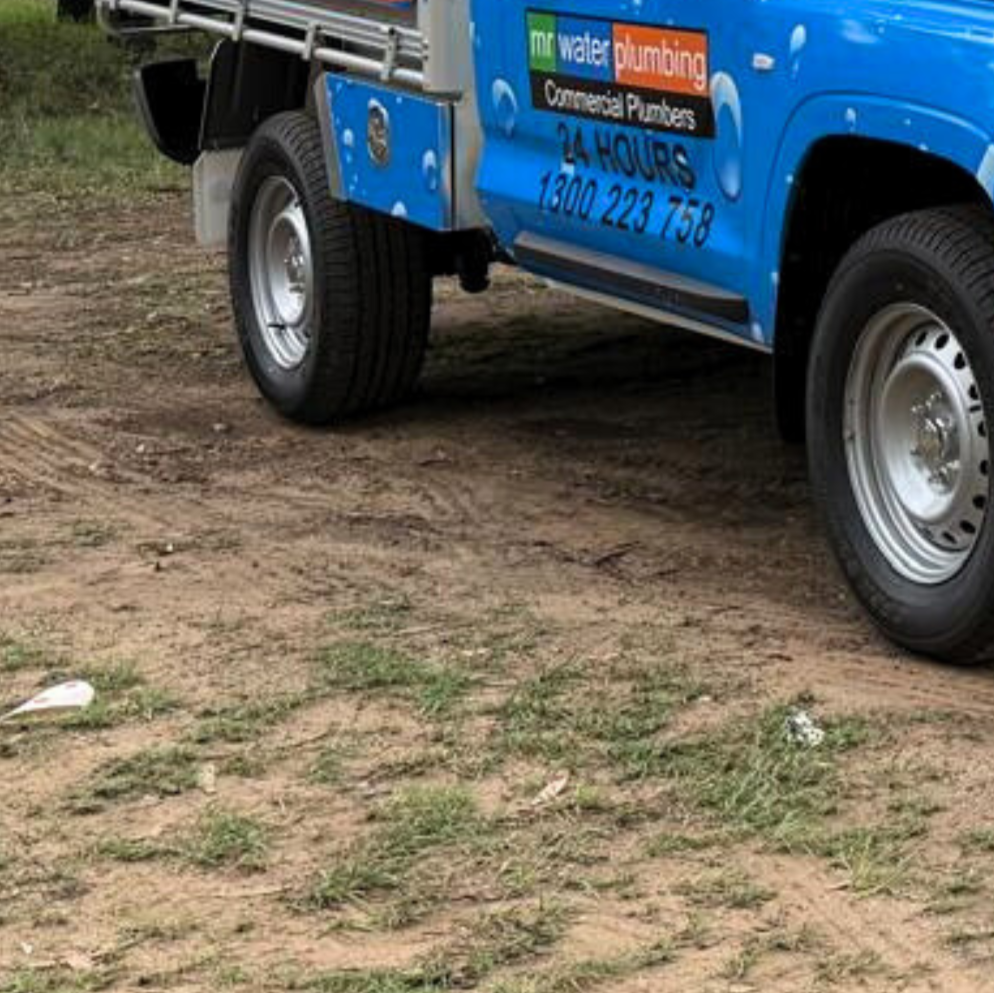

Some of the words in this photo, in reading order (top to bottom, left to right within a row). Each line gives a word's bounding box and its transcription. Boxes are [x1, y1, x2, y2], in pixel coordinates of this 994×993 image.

[529, 29, 555, 57] mr
[558, 30, 611, 68] water
[614, 33, 706, 91] plumbing
[543, 78, 625, 118] Commercial
[626, 92, 697, 131] Plumbers
[557, 121, 591, 169] 24
[594, 126, 696, 190] HOURS
[538, 171, 598, 221] 1300
[601, 183, 655, 234] 223
[660, 193, 716, 248] 758
